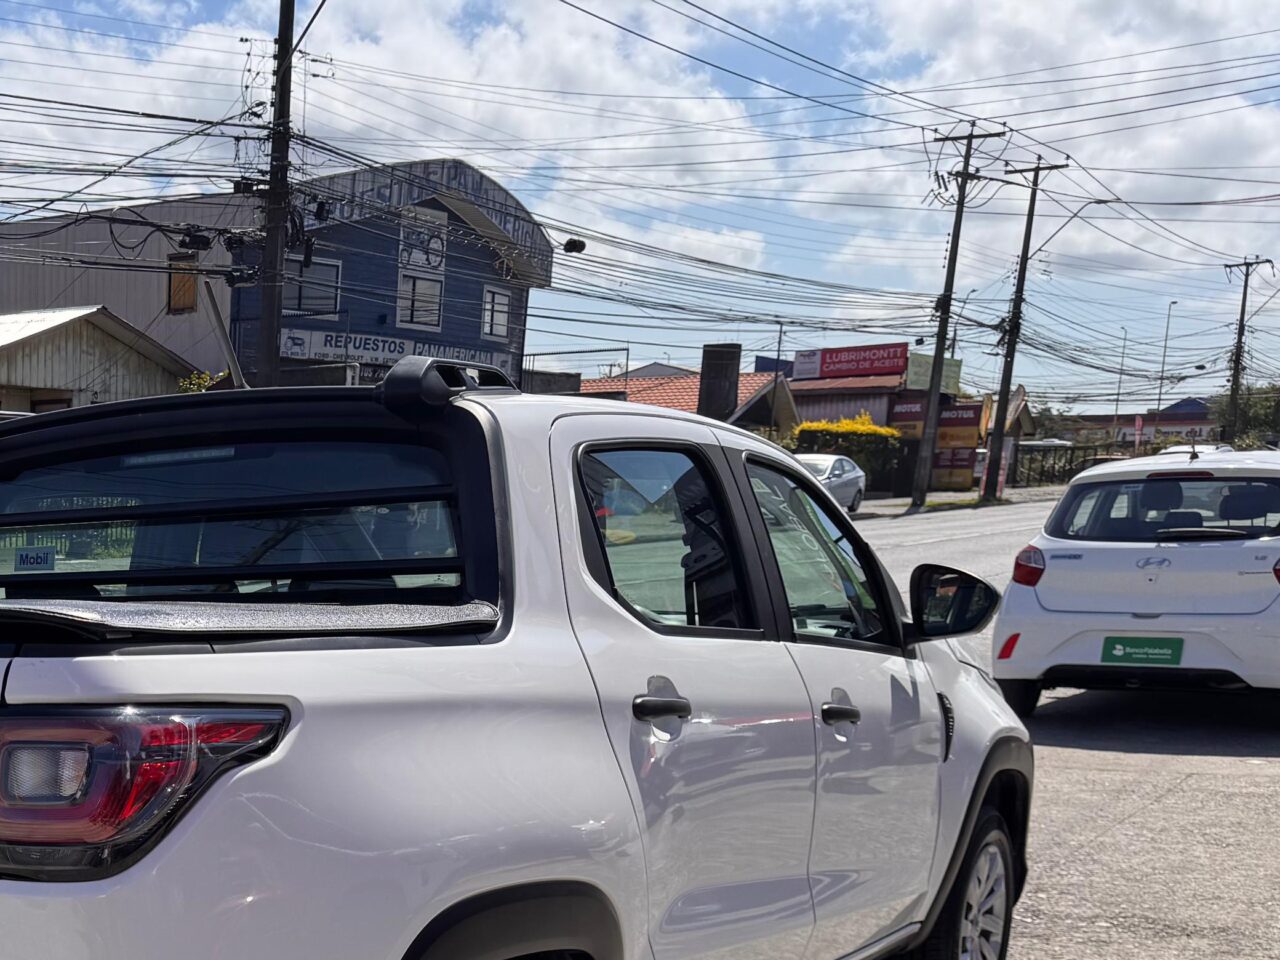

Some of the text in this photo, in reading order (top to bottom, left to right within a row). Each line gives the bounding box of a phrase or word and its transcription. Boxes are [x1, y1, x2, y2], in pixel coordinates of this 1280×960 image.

[323, 333, 406, 354] REPUESTOS
[826, 347, 903, 362] LUBRIMONTT
[823, 358, 904, 371] CAMBIO DE ACEITE
[940, 409, 975, 418] MOTUL
[19, 552, 49, 566] Mobil
